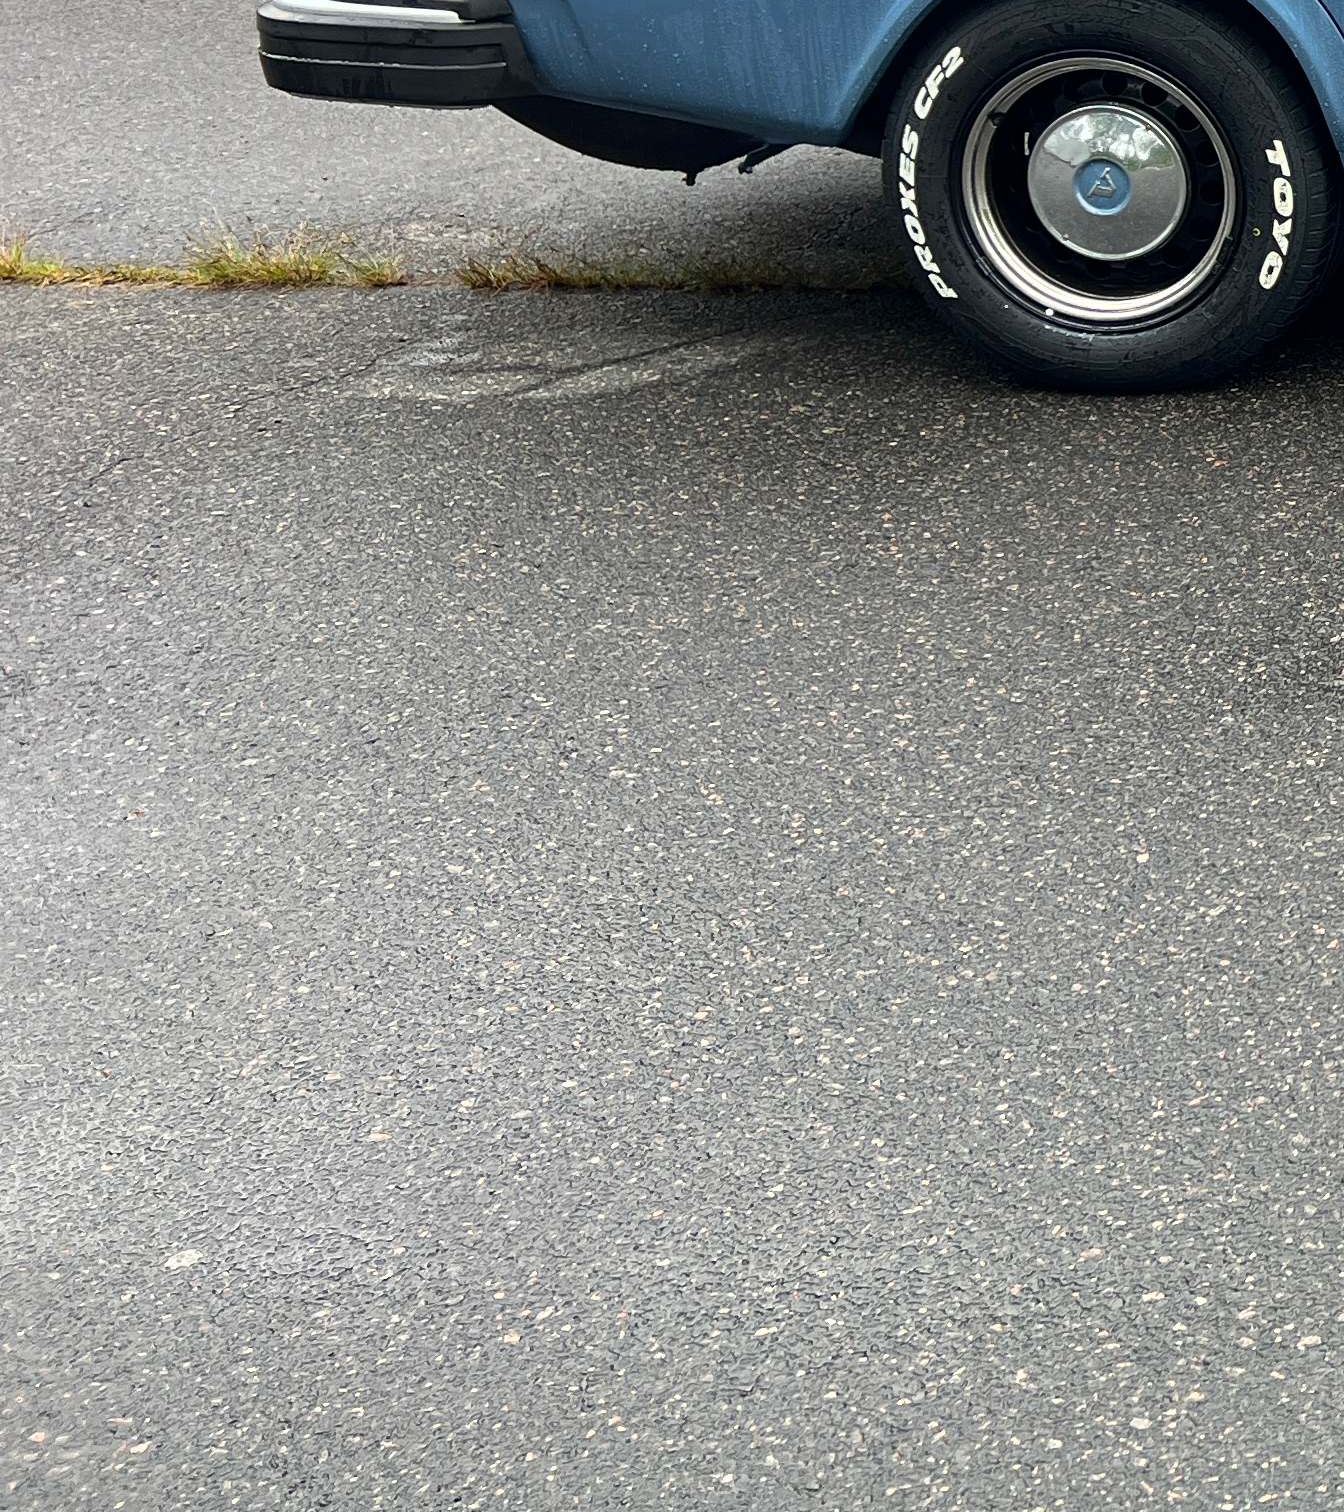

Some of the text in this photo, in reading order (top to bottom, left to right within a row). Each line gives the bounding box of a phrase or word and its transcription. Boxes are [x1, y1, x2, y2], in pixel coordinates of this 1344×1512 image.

[899, 46, 964, 299] PROXES CF2
[1258, 139, 1294, 290] TOYO
